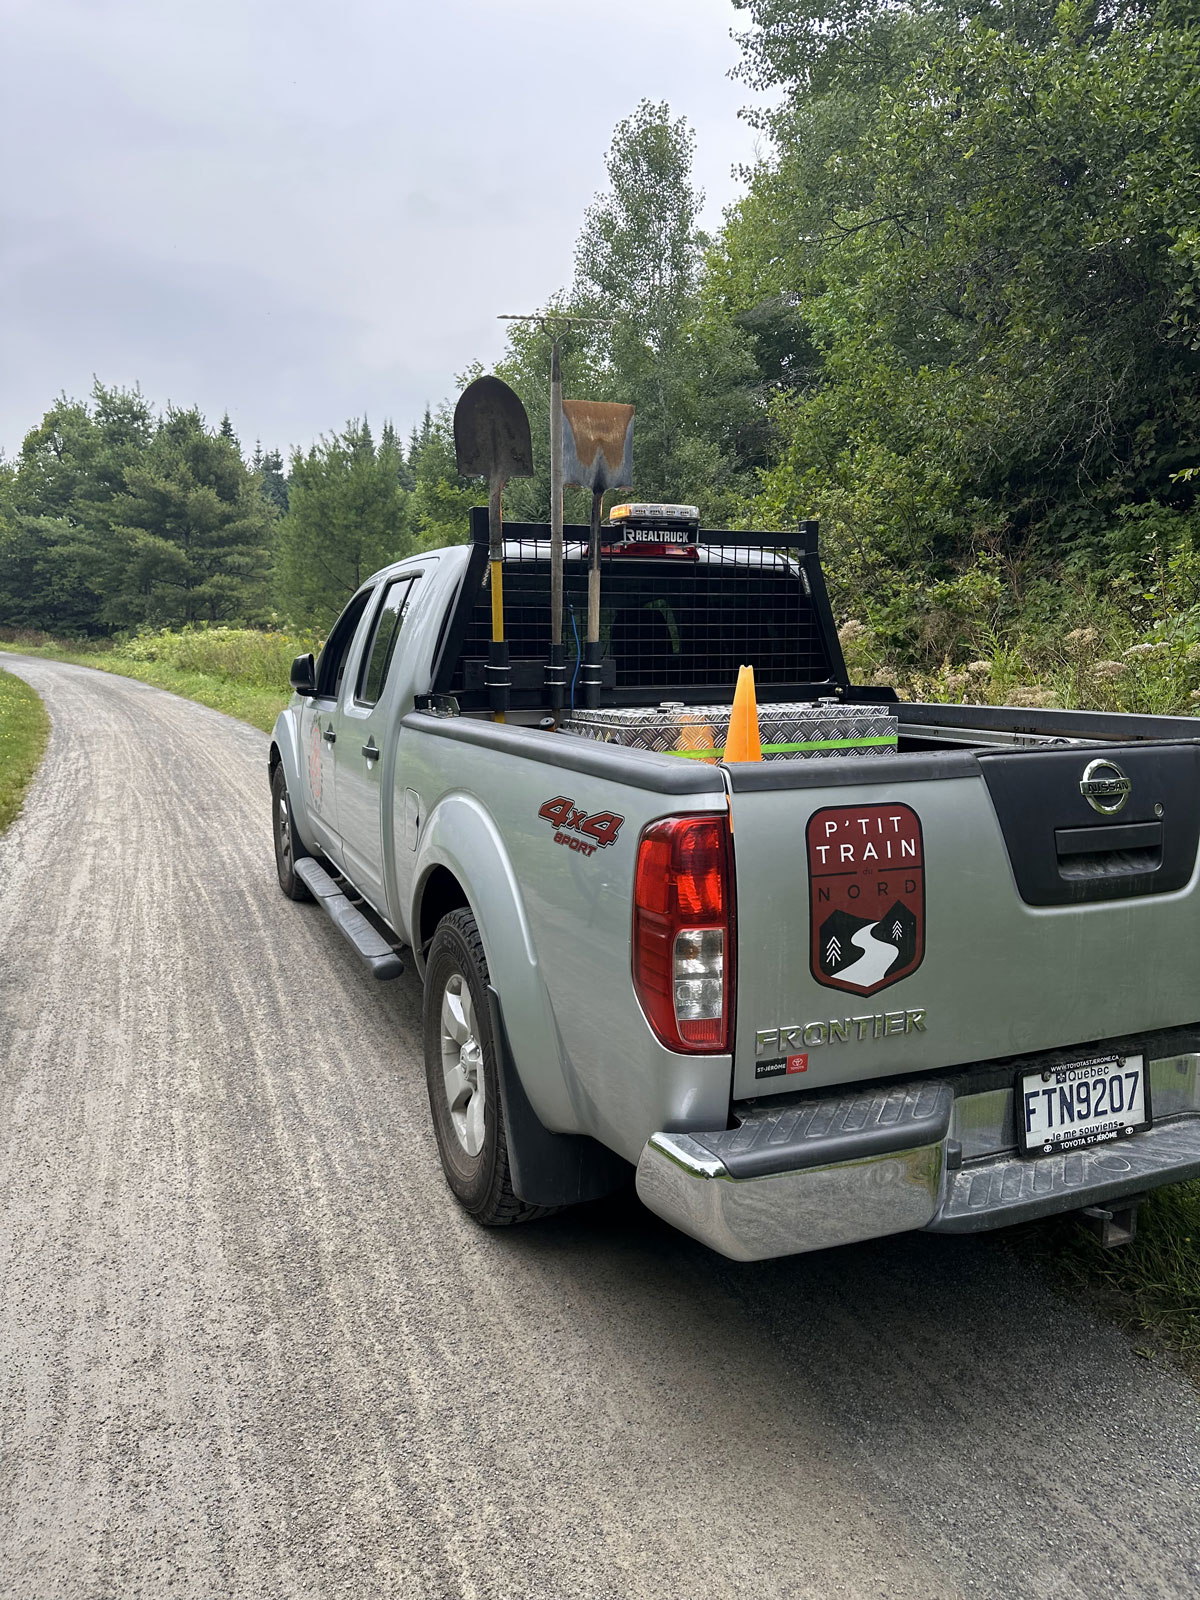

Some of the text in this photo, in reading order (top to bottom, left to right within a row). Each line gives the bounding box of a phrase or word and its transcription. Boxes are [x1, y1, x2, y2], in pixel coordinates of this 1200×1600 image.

[636, 529, 689, 543] REALTRUCK
[1088, 781, 1129, 792] NISSAN
[538, 795, 625, 849] 4x4
[553, 831, 598, 857] SPORT
[815, 838, 917, 864] TRAIN
[862, 866, 874, 875] du
[818, 879, 917, 902] NORD
[755, 1008, 928, 1055] FRONTIER
[1068, 1066, 1109, 1081] Québec
[1024, 1071, 1139, 1132] FTN9207
[1051, 1120, 1118, 1142] Je me souviens
[1061, 1131, 1118, 1149] TOYOTA ST-JÉRÔME
